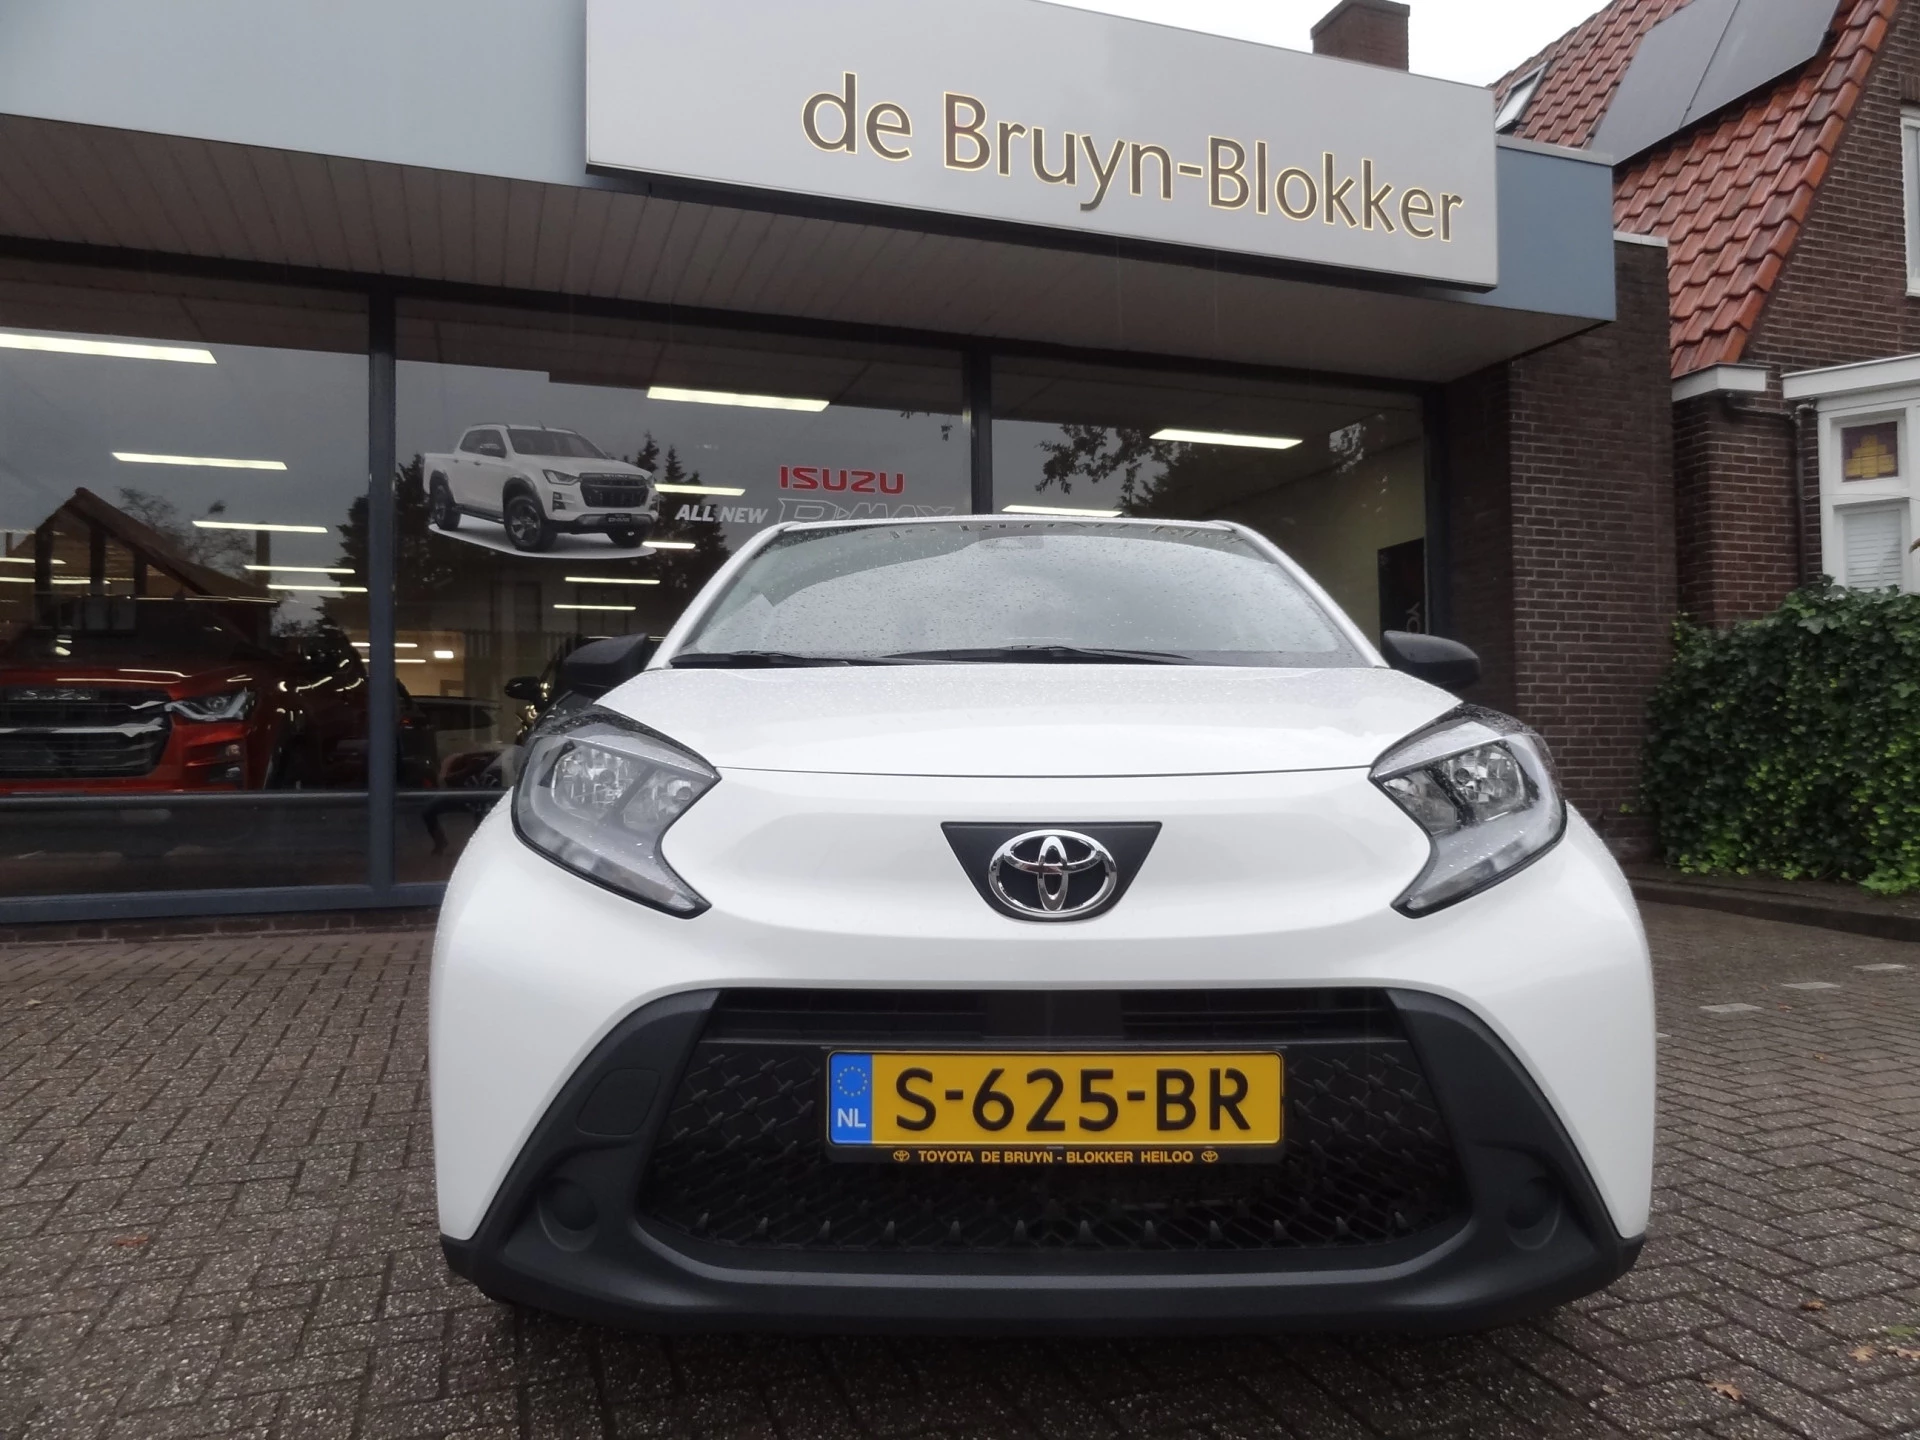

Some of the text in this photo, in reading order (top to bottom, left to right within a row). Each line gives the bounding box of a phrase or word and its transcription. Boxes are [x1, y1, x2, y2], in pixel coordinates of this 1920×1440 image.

[801, 71, 1464, 243] de Bruyn-Blokker
[778, 465, 905, 495] ISUZU
[674, 504, 714, 522] ALL
[719, 506, 768, 524] NEW
[896, 1067, 1252, 1132] S-625-BR
[836, 1108, 867, 1128] NL
[918, 1150, 974, 1162] TOYOTA
[981, 1151, 1001, 1162] DE
[1004, 1151, 1053, 1163] BRUYN
[1066, 1151, 1134, 1163] BLOKKER
[1140, 1151, 1194, 1163] HEILOO
